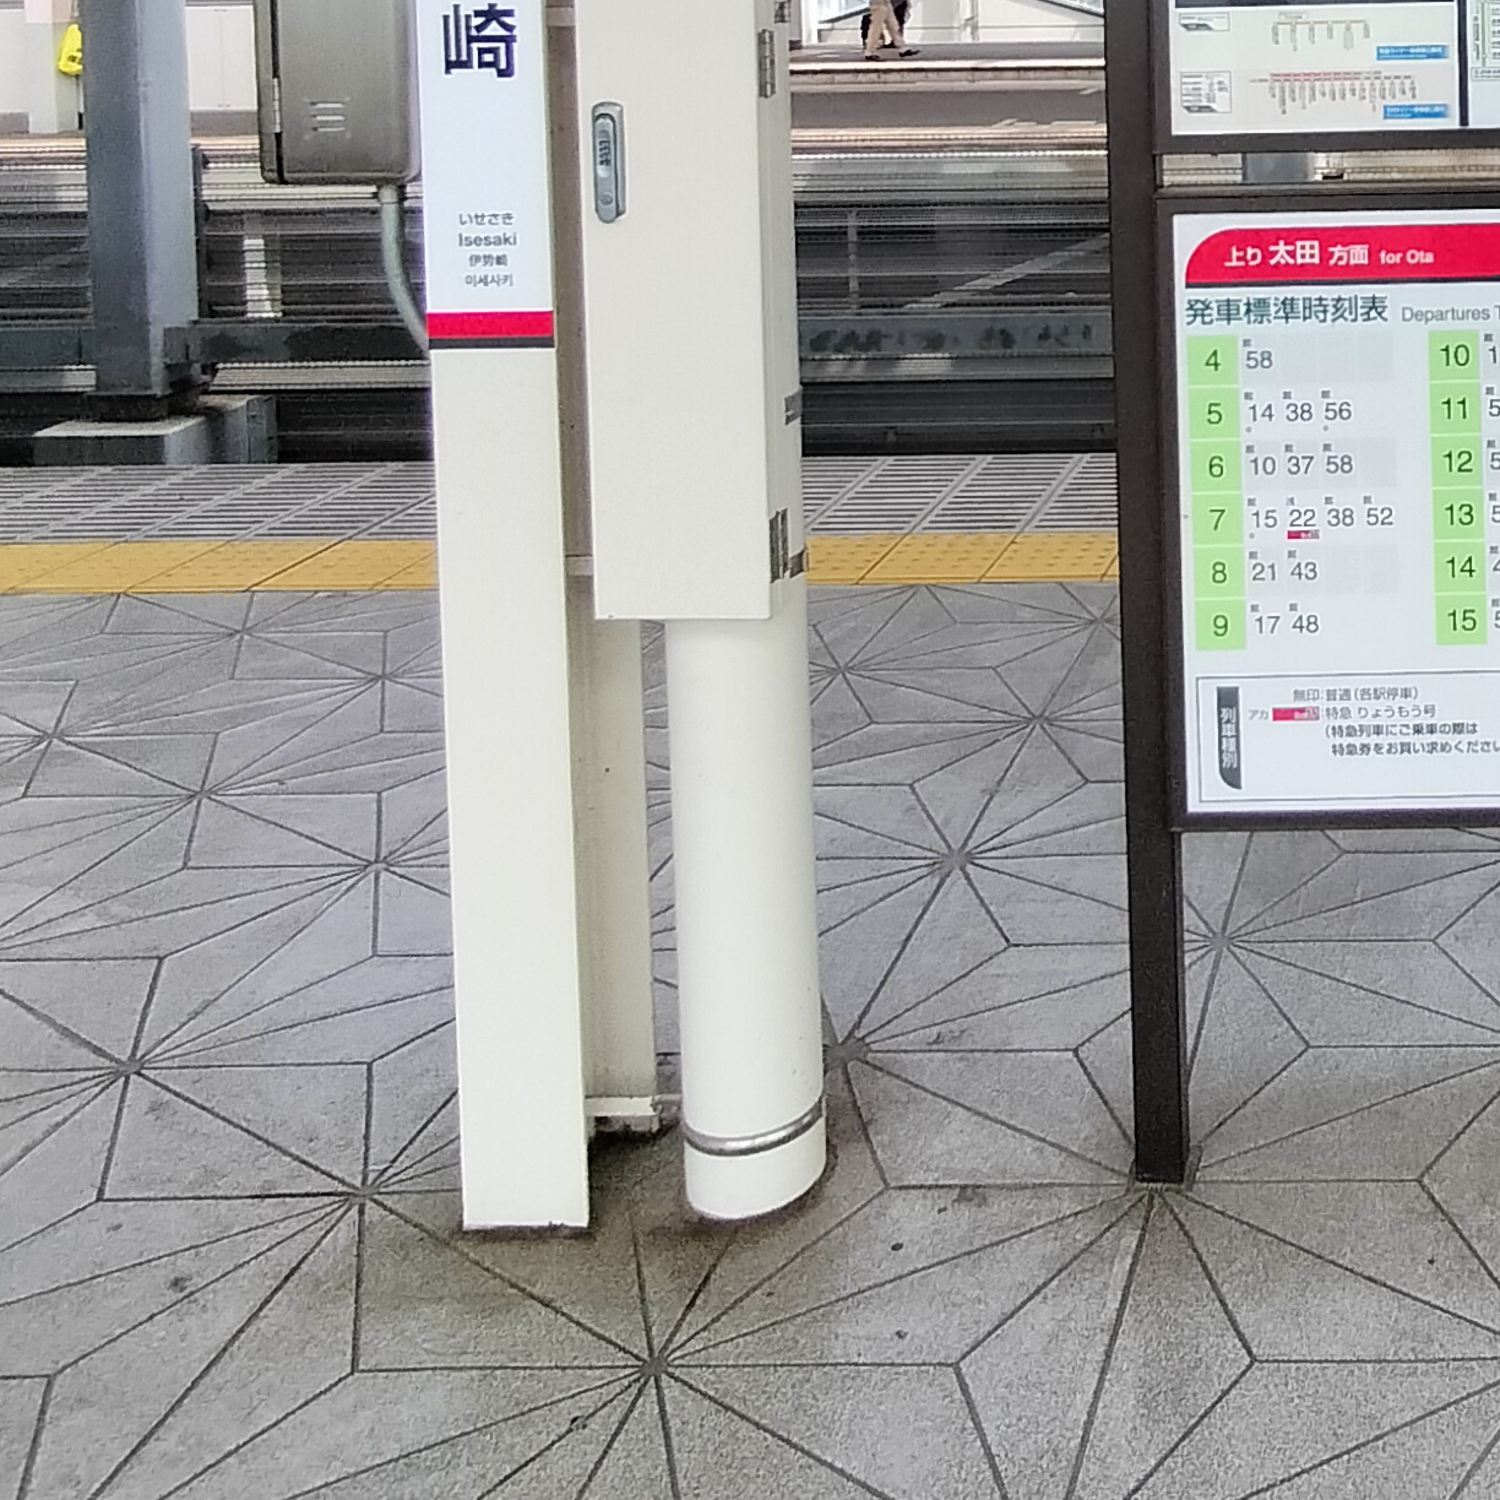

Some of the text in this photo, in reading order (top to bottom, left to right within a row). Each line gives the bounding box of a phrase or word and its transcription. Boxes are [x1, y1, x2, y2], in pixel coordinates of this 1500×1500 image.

[459, 213, 513, 225] いせさき
[459, 233, 516, 247] Isesaki
[1224, 240, 1435, 268] 上り 太田 方面 for Ota
[465, 274, 513, 287] 이세사키
[1185, 295, 1388, 326] 発車標準時刻表
[1402, 307, 1490, 324] Departures
[1205, 350, 1272, 371] 4 58
[1440, 345, 1469, 366] 10
[1207, 402, 1351, 424] 5 14 38 56
[1442, 398, 1466, 419] 11
[1209, 455, 1353, 477] 6 10 37 58
[1444, 451, 1473, 472] 12
[1210, 508, 1393, 531] 7 15 22 38 52
[1445, 504, 1473, 525] 13
[1212, 562, 1317, 583] 8 21 43
[1447, 556, 1475, 578] 14
[1213, 615, 1319, 636] 9 17 48
[1448, 609, 1476, 631] 15
[1357, 703, 1436, 720] りょうもう号
[1220, 707, 1238, 769] 列車種別
